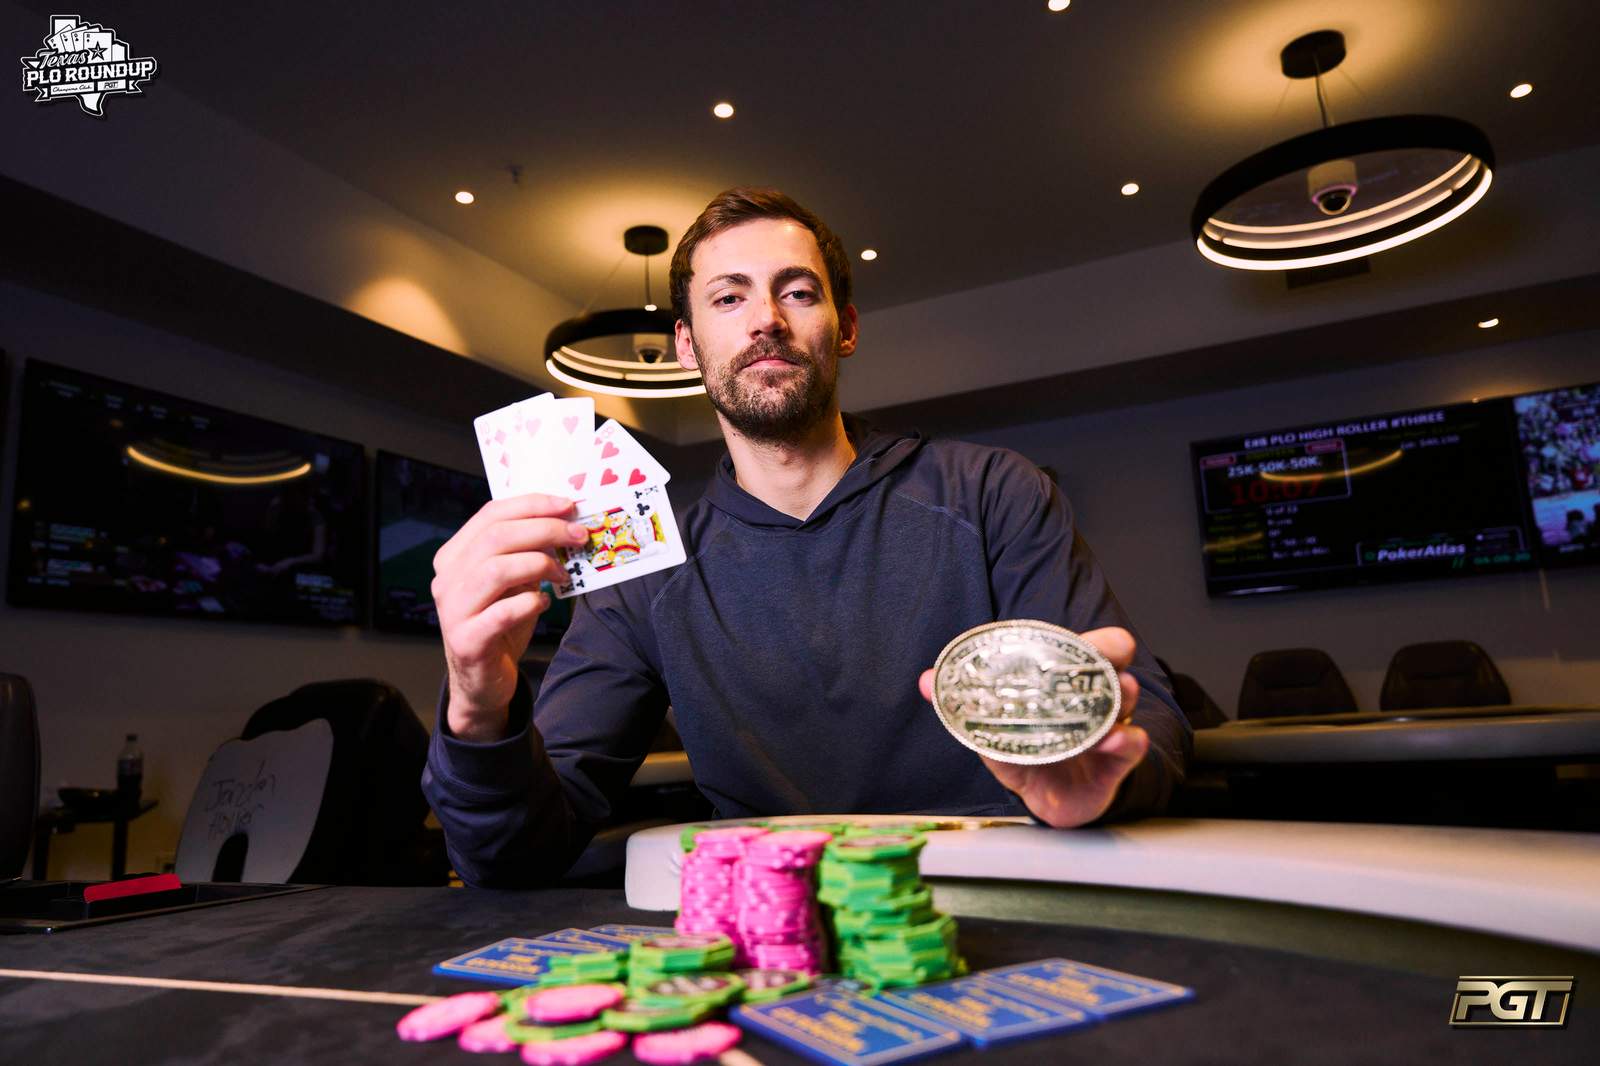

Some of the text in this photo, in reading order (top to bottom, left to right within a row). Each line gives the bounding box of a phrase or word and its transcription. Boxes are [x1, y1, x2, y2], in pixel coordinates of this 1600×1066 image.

[1270, 432, 1296, 446] PLO
[1299, 427, 1334, 441] HIGH
[1336, 418, 1388, 437] ROLLER
[1391, 409, 1446, 428] #THREE
[1376, 543, 1466, 563] PokerAtlas
